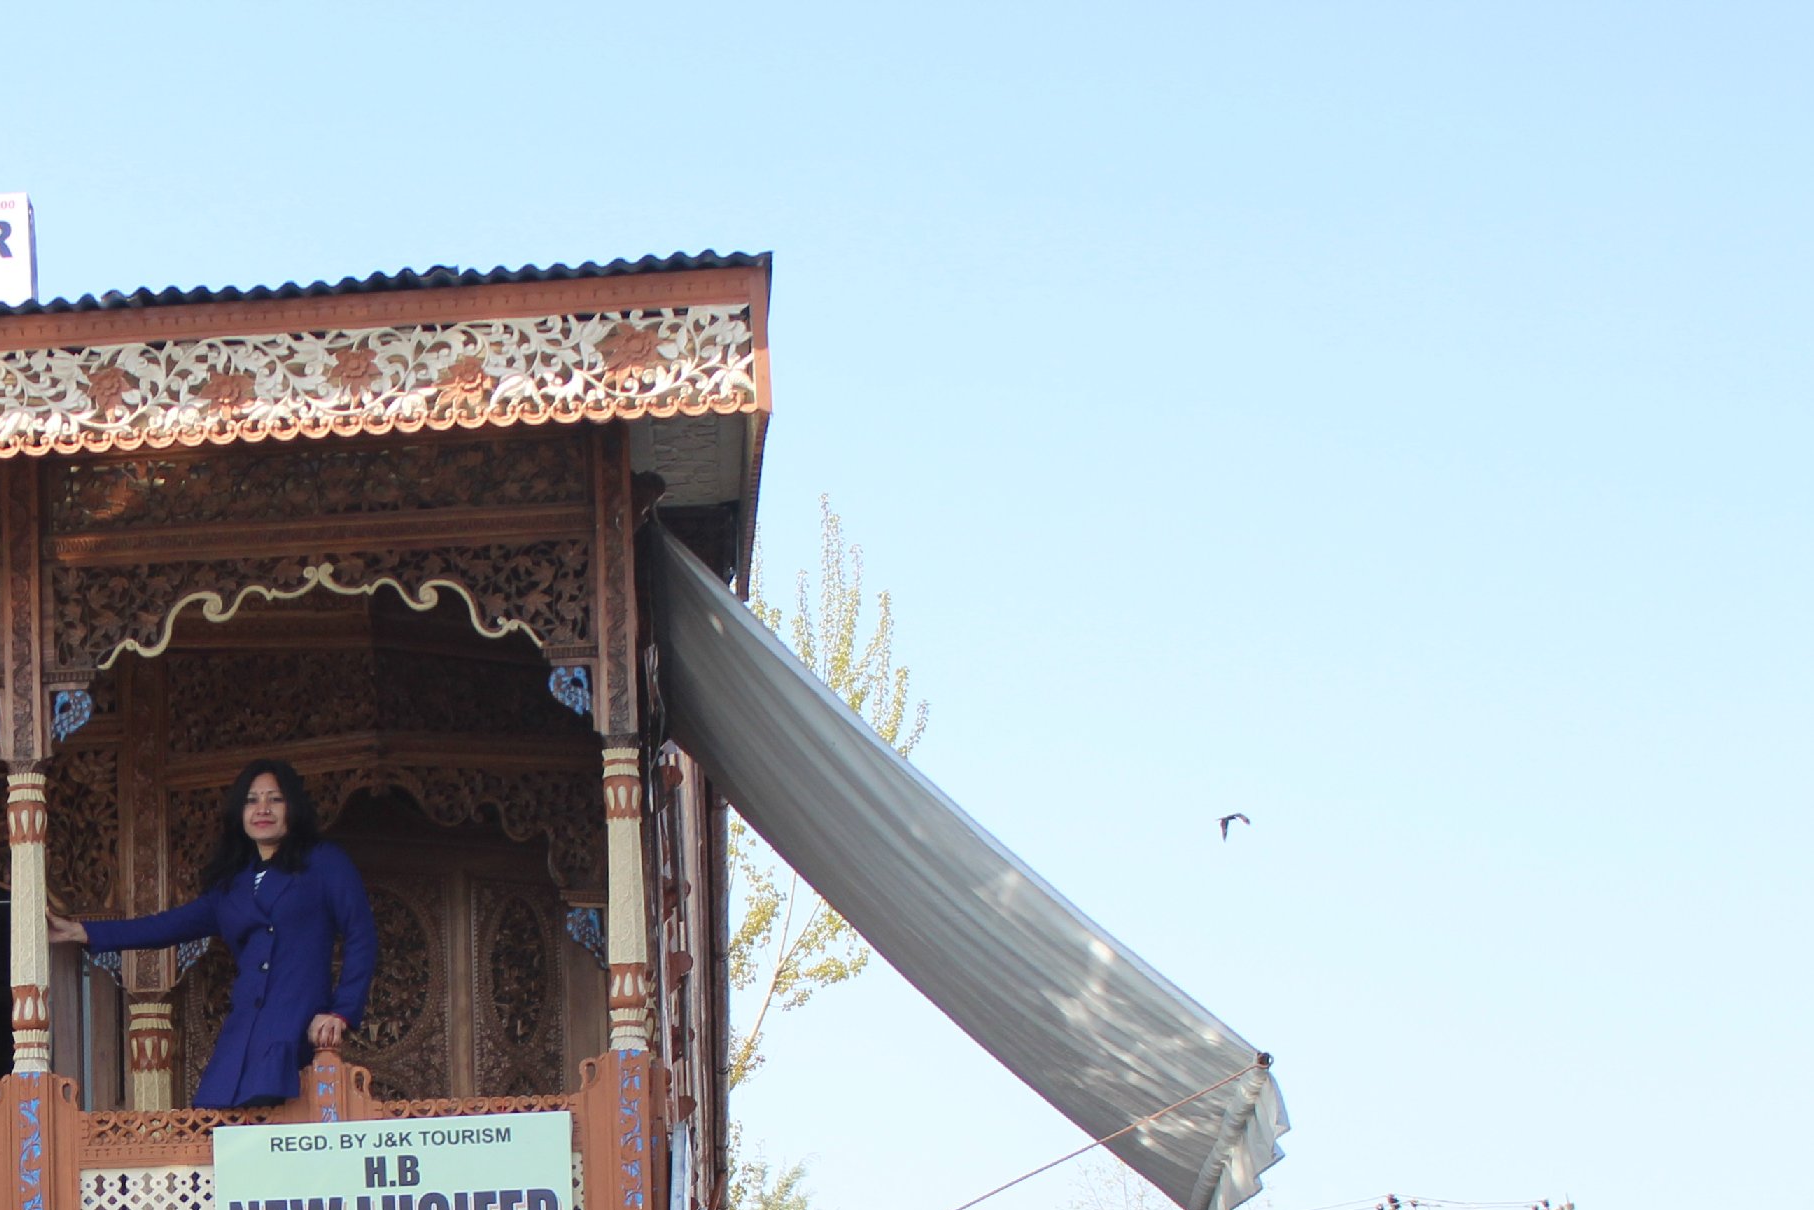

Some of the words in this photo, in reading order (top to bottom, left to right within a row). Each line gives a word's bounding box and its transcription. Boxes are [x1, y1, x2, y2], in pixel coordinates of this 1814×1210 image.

[270, 1136, 333, 1152] REGD.
[340, 1134, 367, 1148] BY
[373, 1132, 413, 1148] J&K
[418, 1127, 512, 1146] TOURISM
[364, 1155, 421, 1188] H.B
